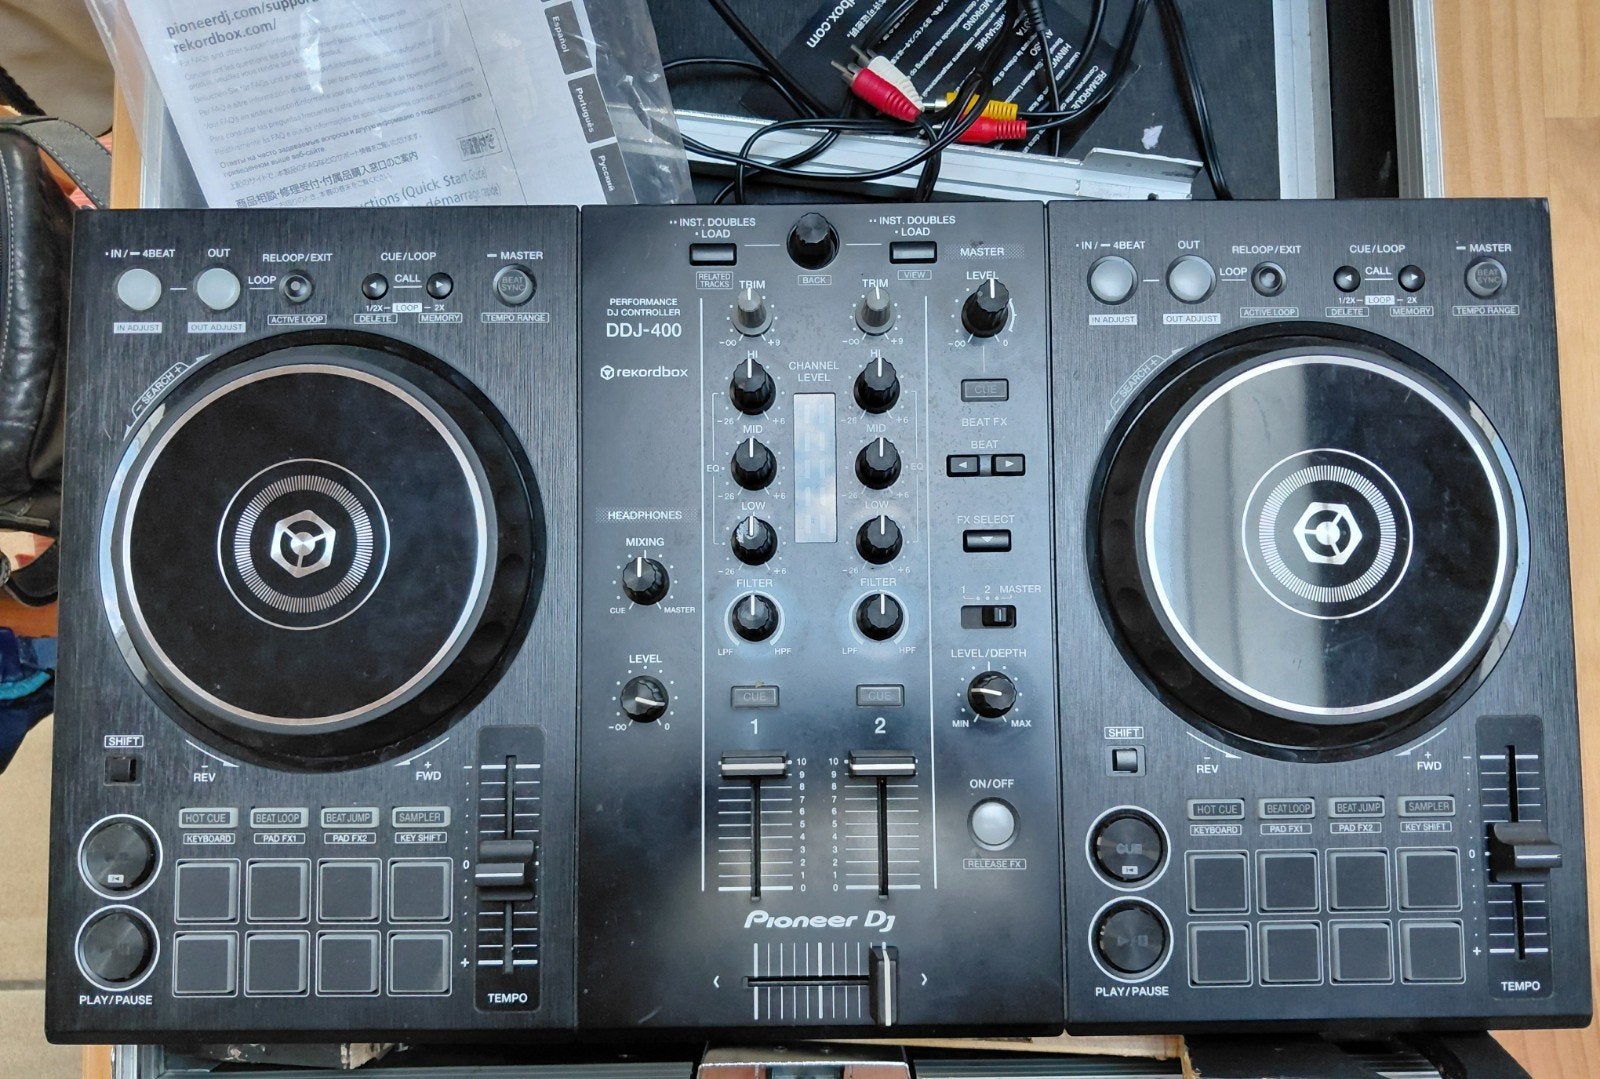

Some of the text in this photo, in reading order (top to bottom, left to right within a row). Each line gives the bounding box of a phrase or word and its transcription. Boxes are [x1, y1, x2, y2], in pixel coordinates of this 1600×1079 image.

[167, 0, 319, 37] pioneerdj.com/suppo
[174, 18, 277, 53] rekordbox.com/
[552, 16, 569, 53] Español
[1071, 70, 1107, 109] REMARQUE
[576, 87, 594, 133] Português
[598, 155, 614, 191] Русский
[402, 172, 468, 200] (Quick Start
[679, 218, 756, 227] INST. DOUBLES
[879, 216, 956, 225] INST. DOUBLES
[701, 230, 730, 238] LOAD
[901, 228, 931, 236] LOAD
[1113, 241, 1146, 250] 4BEAT
[1177, 240, 1200, 249] OUT
[1470, 243, 1512, 252] MASTER
[142, 249, 176, 258] 4BEAT
[207, 248, 231, 258] OUT
[960, 248, 1005, 257] MASTER
[1232, 245, 1301, 254] RELOOP/EXIT
[1349, 245, 1406, 254] CUE/LOOP
[262, 252, 333, 262] RELOOP/EXIT
[380, 252, 437, 261] CUE/LOOP
[500, 251, 544, 260] MASTER
[904, 271, 925, 279] VIEW
[966, 271, 999, 280] LEVEL
[1219, 267, 1247, 276] LOOP
[1365, 267, 1392, 275] CALL
[248, 276, 276, 285] LOOP
[394, 274, 421, 283] CALL
[698, 273, 731, 281] RELATED
[802, 276, 827, 284] BACK
[700, 280, 729, 288] TRACKS
[739, 280, 766, 289] TRIM
[862, 279, 888, 288] TRIM
[609, 298, 678, 306] PERFORMANCE
[606, 308, 681, 316] DJ CONTROLLER
[1243, 308, 1296, 316] ACTIVE LOOP
[1331, 308, 1364, 316] DELETE
[1392, 307, 1431, 315] MEMORY
[1456, 307, 1485, 315] TEMPO
[271, 316, 298, 324] ACTIVE
[359, 315, 392, 323] DELETE
[421, 314, 460, 322] MEMORY
[486, 314, 546, 322] TEMPO RANGE
[1091, 315, 1135, 323] IN ADJUST
[117, 323, 160, 332] IN ADJUST
[191, 323, 243, 332] OUT ADJUST
[606, 322, 682, 338] DDJ-400
[747, 351, 758, 359] HI
[870, 349, 881, 358] HI
[789, 362, 839, 370] CHANNEL
[617, 366, 688, 378] rekordbox
[798, 373, 831, 382] LEVEL
[1120, 364, 1152, 397] SEARCH
[142, 372, 174, 404] SEARCH
[974, 385, 997, 394] CUE
[962, 417, 1008, 426] BEAT FX
[743, 425, 763, 434] MID
[866, 424, 886, 432] MID
[971, 440, 999, 449] BEAT
[707, 465, 720, 473] EQ
[741, 502, 766, 510] LOW
[865, 501, 889, 509] LOW
[608, 511, 682, 520] HEADPHONES
[957, 515, 1015, 524] FX SELECT
[625, 538, 665, 547] MIXING
[736, 579, 773, 588] FILTER
[860, 578, 897, 587] FILTER
[1000, 585, 1041, 593] MASTER
[717, 648, 733, 656] LPF
[842, 647, 858, 655] LPF
[899, 646, 917, 654] HPF
[951, 649, 1027, 658] LEVEL/DEPTH
[629, 655, 662, 664] LEVEL
[750, 719, 758, 734] 1
[874, 717, 886, 734] 2
[1108, 728, 1139, 737] SHIFT
[108, 737, 139, 746] SHIFT
[1196, 764, 1219, 774] REV
[1417, 762, 1442, 771] FWD
[193, 773, 216, 782] REV
[416, 771, 441, 781] FWD
[969, 779, 1014, 789] ON/OFF
[1197, 805, 1238, 814] HOT CUE
[1267, 804, 1310, 813] BEAT LOOP
[1337, 803, 1380, 812] BEAT JUMP
[1409, 802, 1450, 811] SAMPLER
[185, 814, 226, 823] HOT CUE
[256, 814, 299, 823] BEAT LOOP
[326, 814, 370, 822] BEAT JUMP
[400, 813, 440, 821] SAMPLER
[1193, 825, 1238, 834] KEYBOARD
[1339, 824, 1373, 832] PAD FX2
[1406, 823, 1446, 831] KEY SHIFT
[186, 835, 232, 843] KEYBOARD
[332, 834, 367, 842] PAD FX2
[968, 860, 1021, 868] RELEASE FX
[744, 910, 858, 929] Pioneer
[1501, 981, 1540, 992] TEMPO
[1095, 986, 1169, 997] PLAY/PAUSE
[79, 995, 153, 1005] PLAY/PAUSE
[488, 993, 528, 1003] TEMPO
